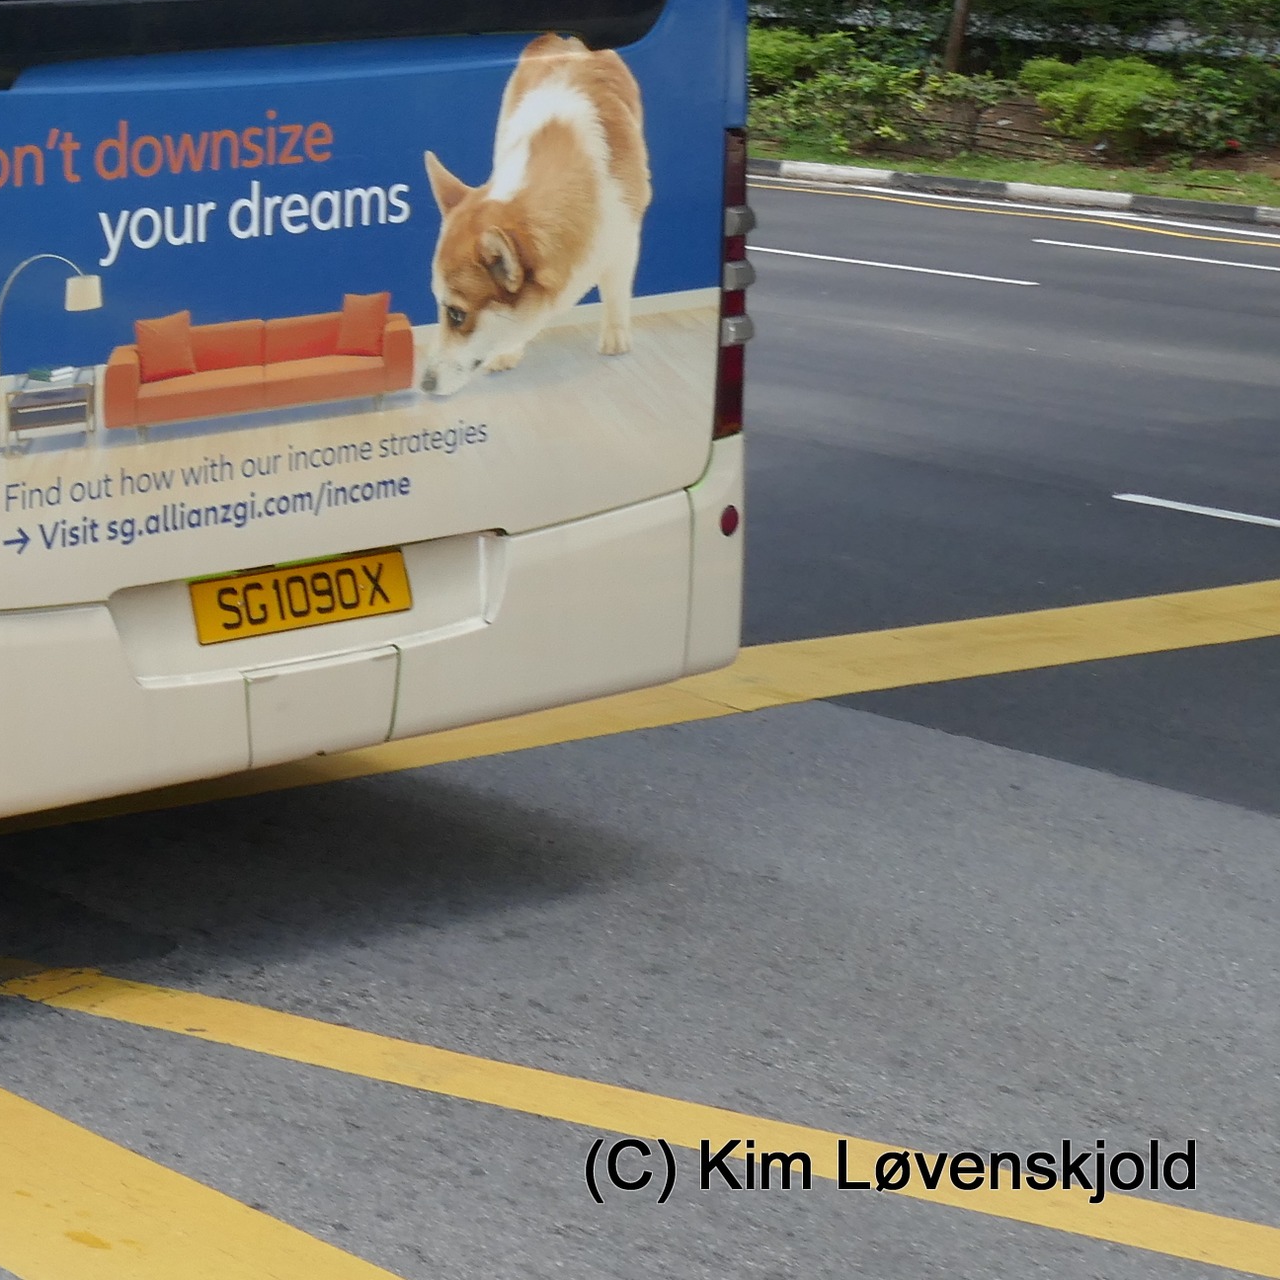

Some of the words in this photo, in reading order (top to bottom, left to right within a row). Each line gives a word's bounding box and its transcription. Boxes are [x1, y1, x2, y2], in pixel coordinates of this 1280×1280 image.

[94, 109, 334, 182] downsize
[98, 200, 217, 268] your
[227, 179, 411, 240] dreams
[4, 477, 62, 513] Find
[70, 476, 113, 502] out
[120, 468, 173, 496] how
[181, 454, 235, 486] with
[241, 452, 282, 480] our
[288, 441, 373, 472] income
[378, 419, 489, 459] strategies
[39, 516, 100, 551] Visit
[106, 473, 412, 546] sg.allianzgi.com/income
[216, 562, 391, 631] SG1090X
